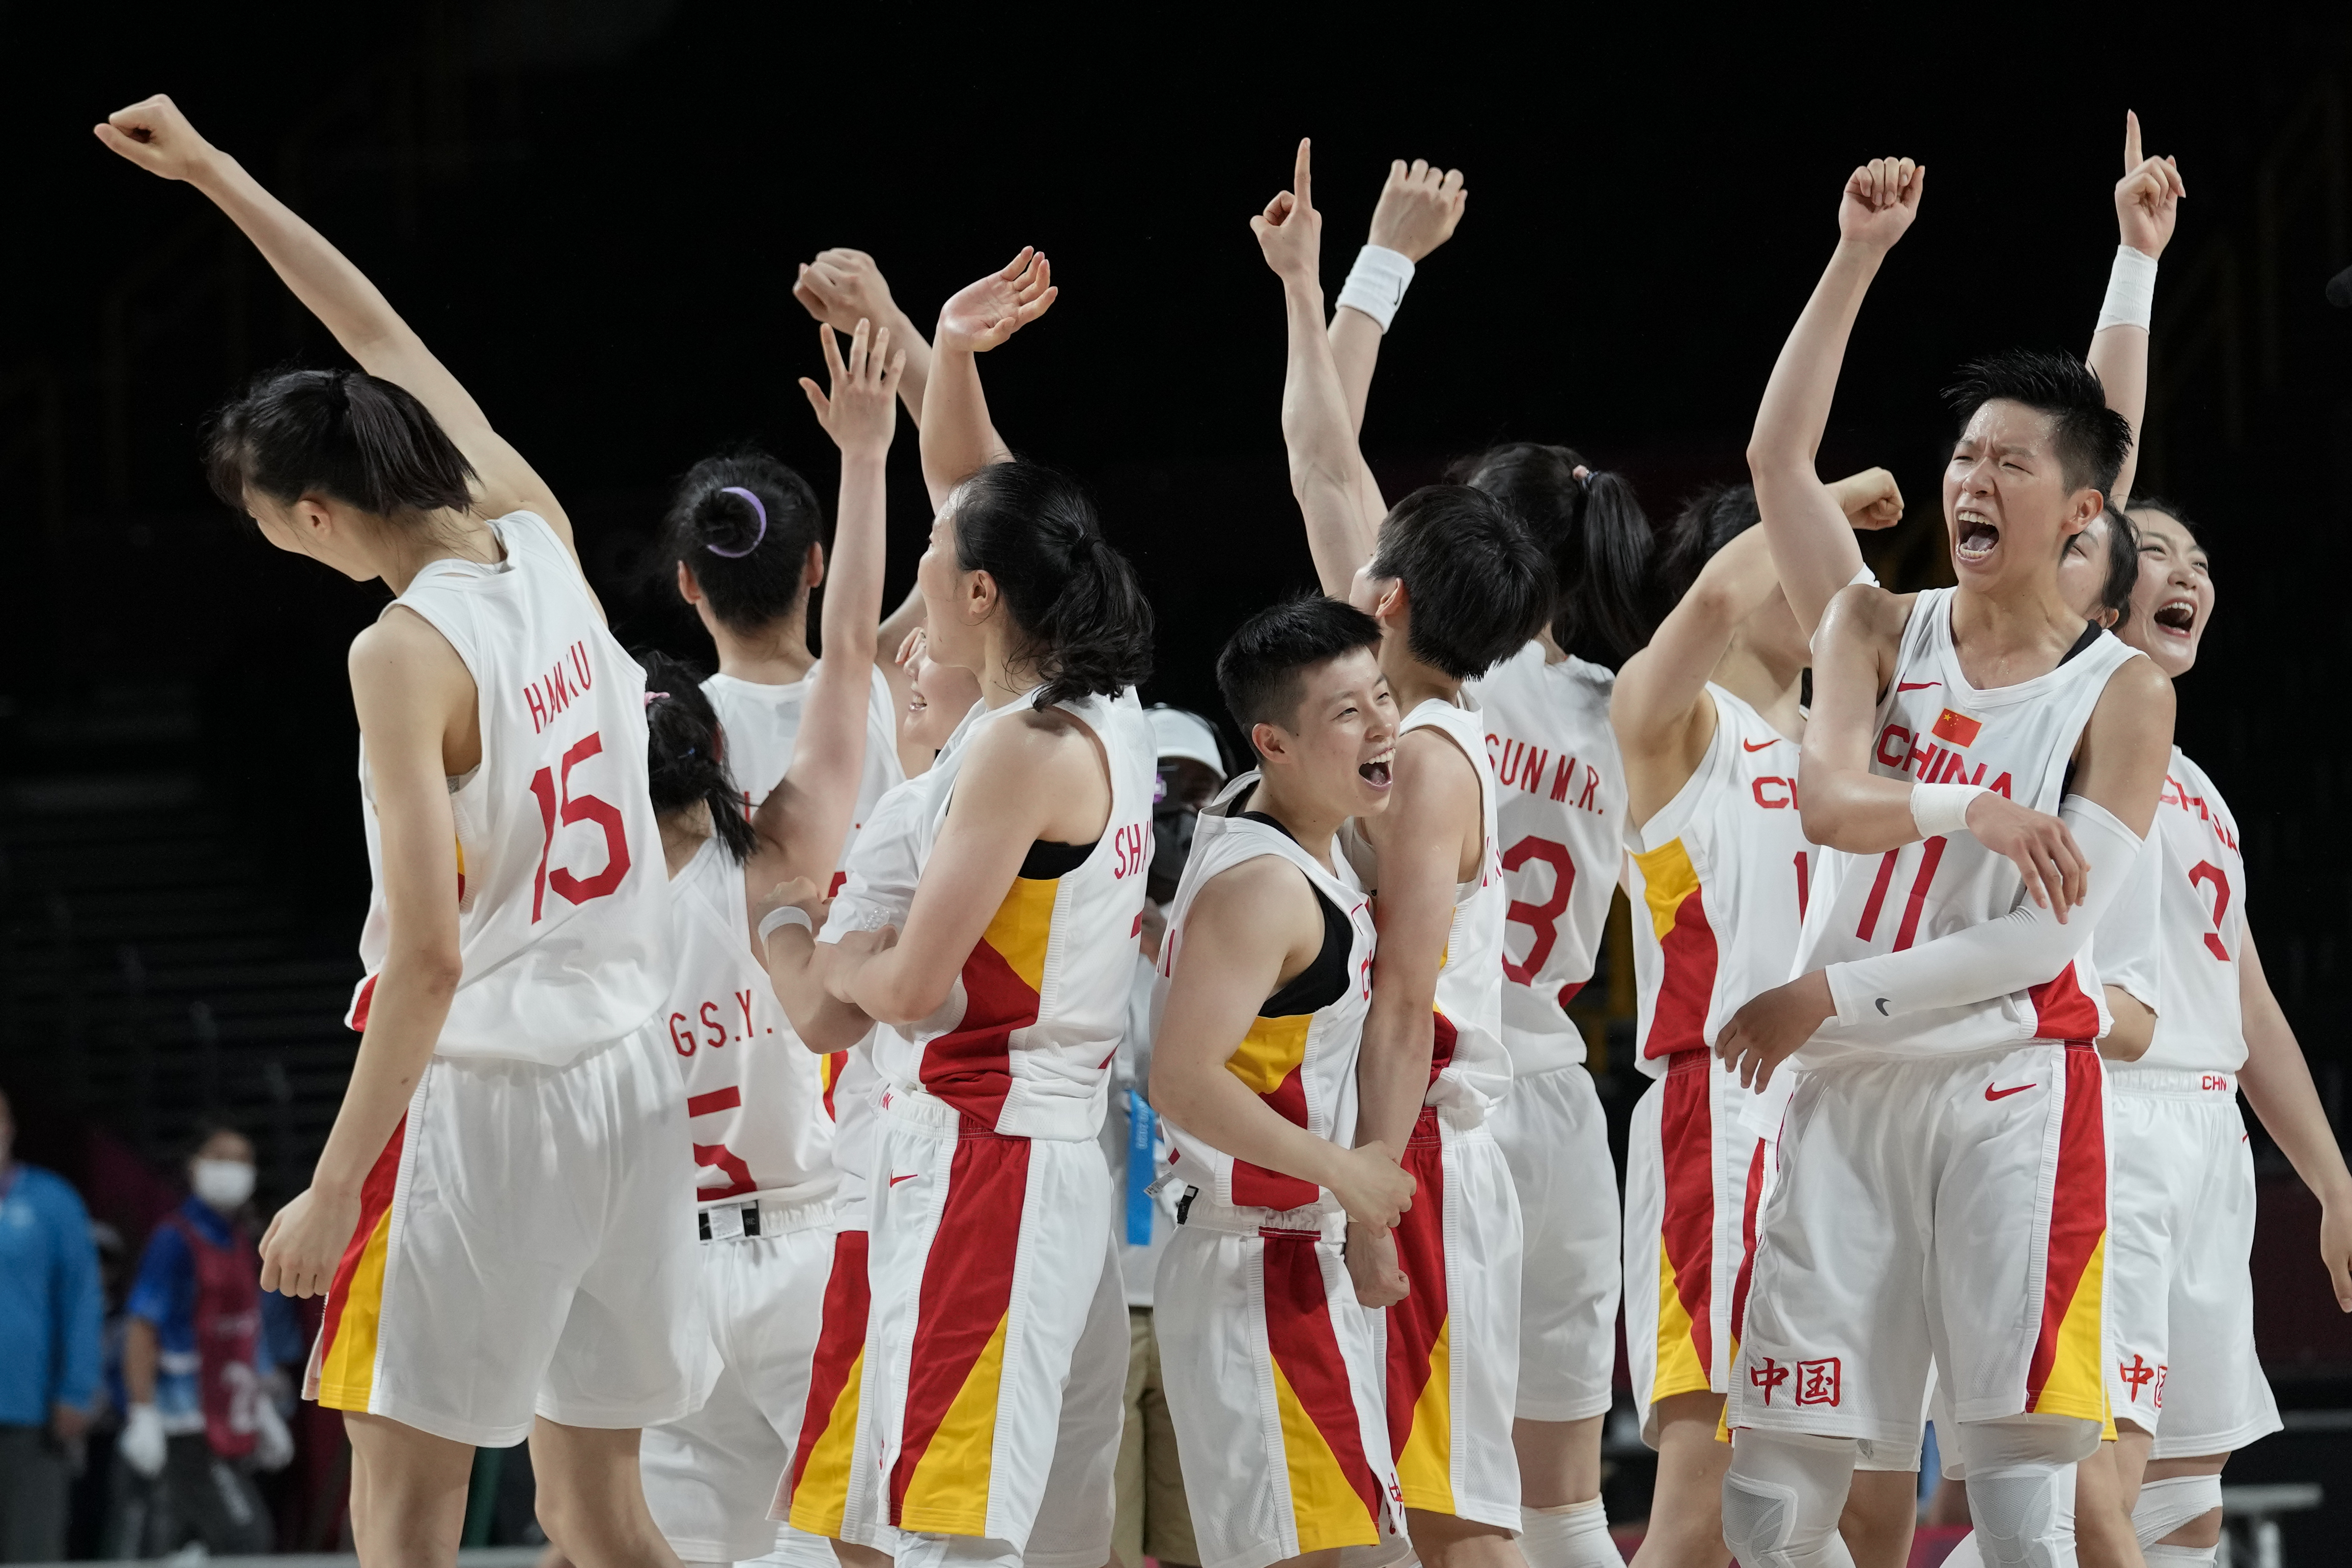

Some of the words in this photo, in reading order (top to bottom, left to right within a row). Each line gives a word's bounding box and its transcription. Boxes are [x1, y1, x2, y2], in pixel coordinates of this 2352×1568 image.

[530, 731, 631, 926] 15
[1856, 835, 1948, 954] 11
[2202, 1076, 2226, 1091] CHN
[1751, 1357, 1841, 1407] 中国
